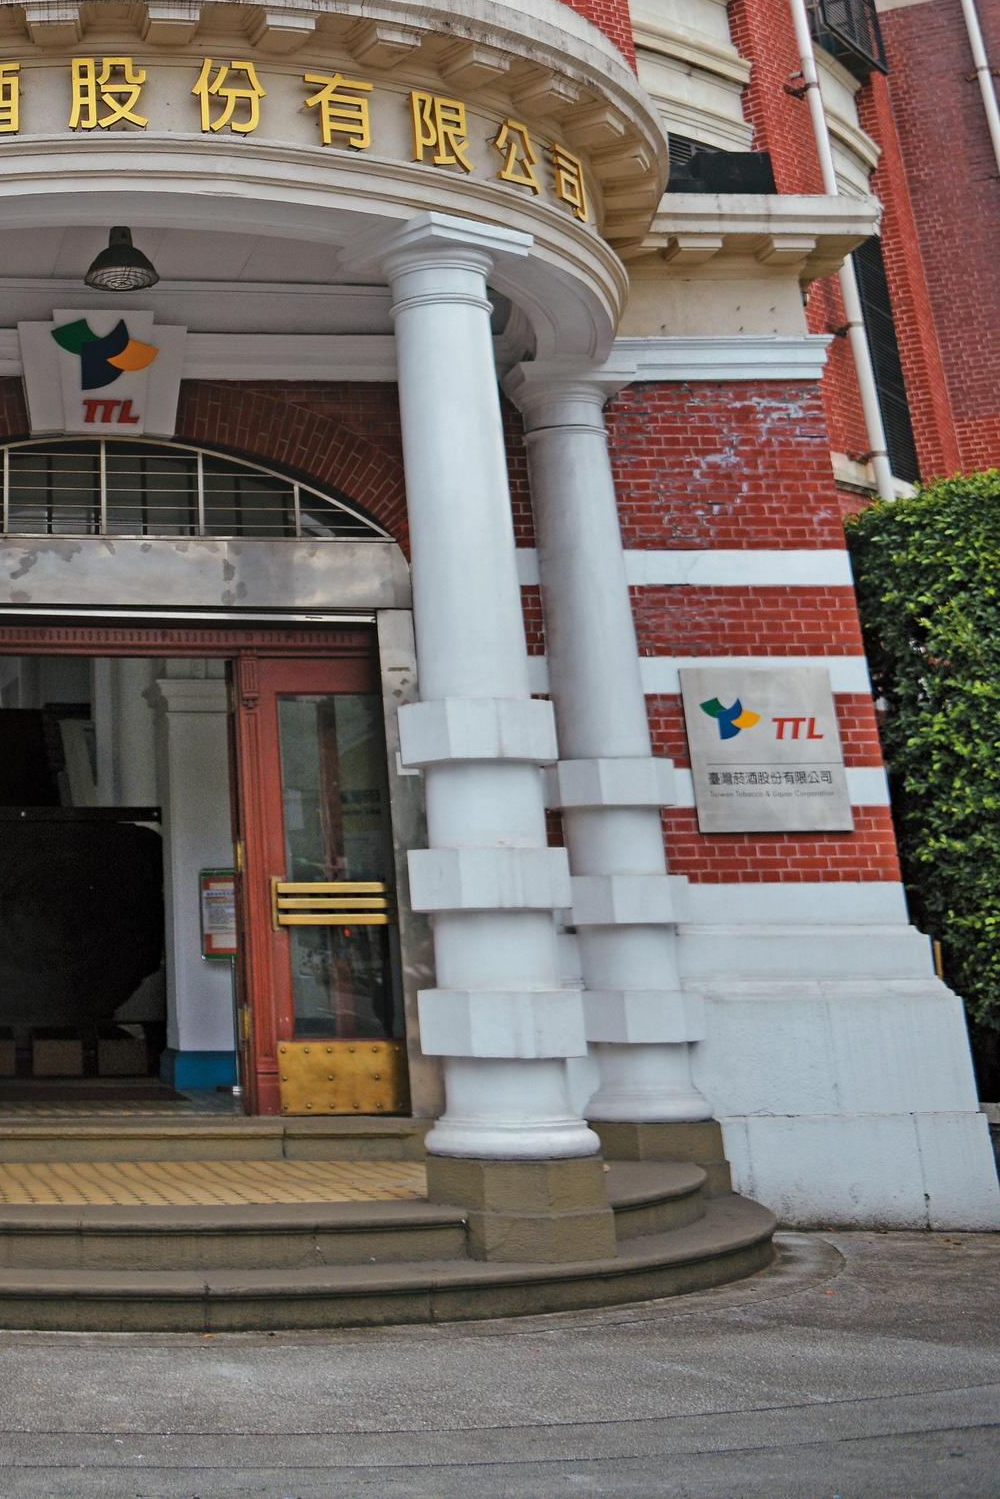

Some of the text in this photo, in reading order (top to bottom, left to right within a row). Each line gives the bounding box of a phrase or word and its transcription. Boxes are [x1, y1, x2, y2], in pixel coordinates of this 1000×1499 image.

[82, 399, 140, 424] TTL
[772, 717, 824, 740] TTL
[708, 771, 833, 785] 臺灣菸酒股份有限公司
